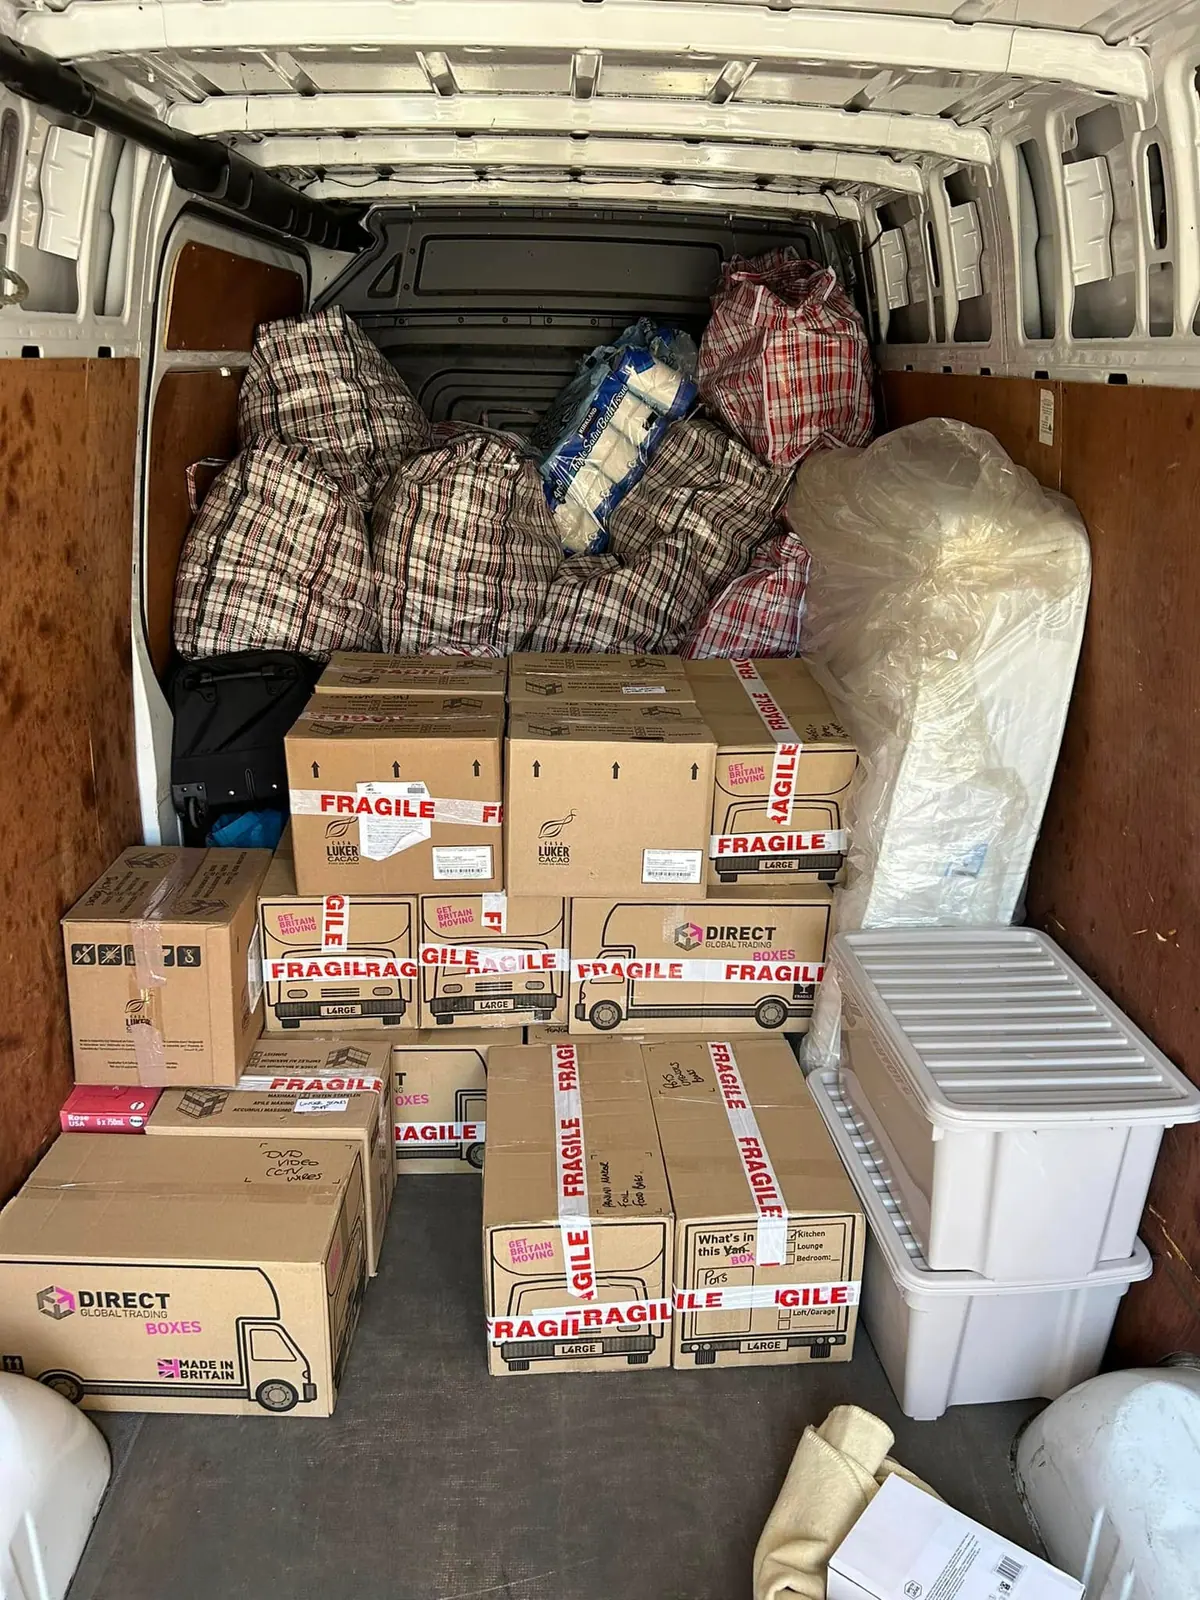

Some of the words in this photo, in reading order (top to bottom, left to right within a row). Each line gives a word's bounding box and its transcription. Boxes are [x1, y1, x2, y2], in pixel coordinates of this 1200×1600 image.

[578, 407, 598, 434] KIRKLAND
[583, 432, 602, 452] Satin
[596, 406, 616, 430] Bath
[609, 384, 629, 409] Tissue
[752, 692, 790, 731] FRAGILE
[728, 763, 744, 772] GET
[729, 766, 764, 779] BRITAIN
[730, 774, 766, 786] MOVING
[320, 795, 436, 819] FRAGILE
[717, 833, 826, 854] FRAGILE
[326, 845, 359, 857] LUKER
[538, 846, 570, 857] LUKER
[436, 905, 452, 914] GET
[437, 908, 473, 922] BRITAIN
[277, 912, 294, 922] GET
[279, 916, 316, 929] BRITAIN
[439, 915, 475, 929] MOVING
[280, 923, 318, 936] MOVING
[705, 926, 777, 941] DIRECT
[705, 940, 736, 949] GLOBAL
[737, 940, 772, 949] TRADING
[752, 949, 796, 962] BOXES
[710, 1043, 746, 1109] FRAGILE
[262, 1149, 303, 1158] DVD
[560, 1117, 585, 1197] FRAGILE
[265, 1167, 303, 1177] CCTV
[738, 1136, 783, 1219] FRAGILE
[698, 1233, 740, 1245] What's
[743, 1232, 755, 1243] in
[797, 1229, 826, 1238] Kitchen
[508, 1238, 527, 1249] GET
[509, 1241, 553, 1256] BRITAIN
[797, 1243, 824, 1251] Lounge
[511, 1250, 555, 1264] MOVING
[698, 1246, 720, 1257] this
[731, 1253, 755, 1265] BOX
[78, 1290, 171, 1309] DIRECT
[80, 1308, 121, 1318] GLOBAL
[121, 1309, 168, 1319] TRADING
[793, 1308, 836, 1317] Loft/Garage
[146, 1321, 202, 1335] BOXES
[179, 1359, 217, 1370] MADE
[220, 1359, 235, 1370] IN
[180, 1369, 235, 1381] BRITAIN
